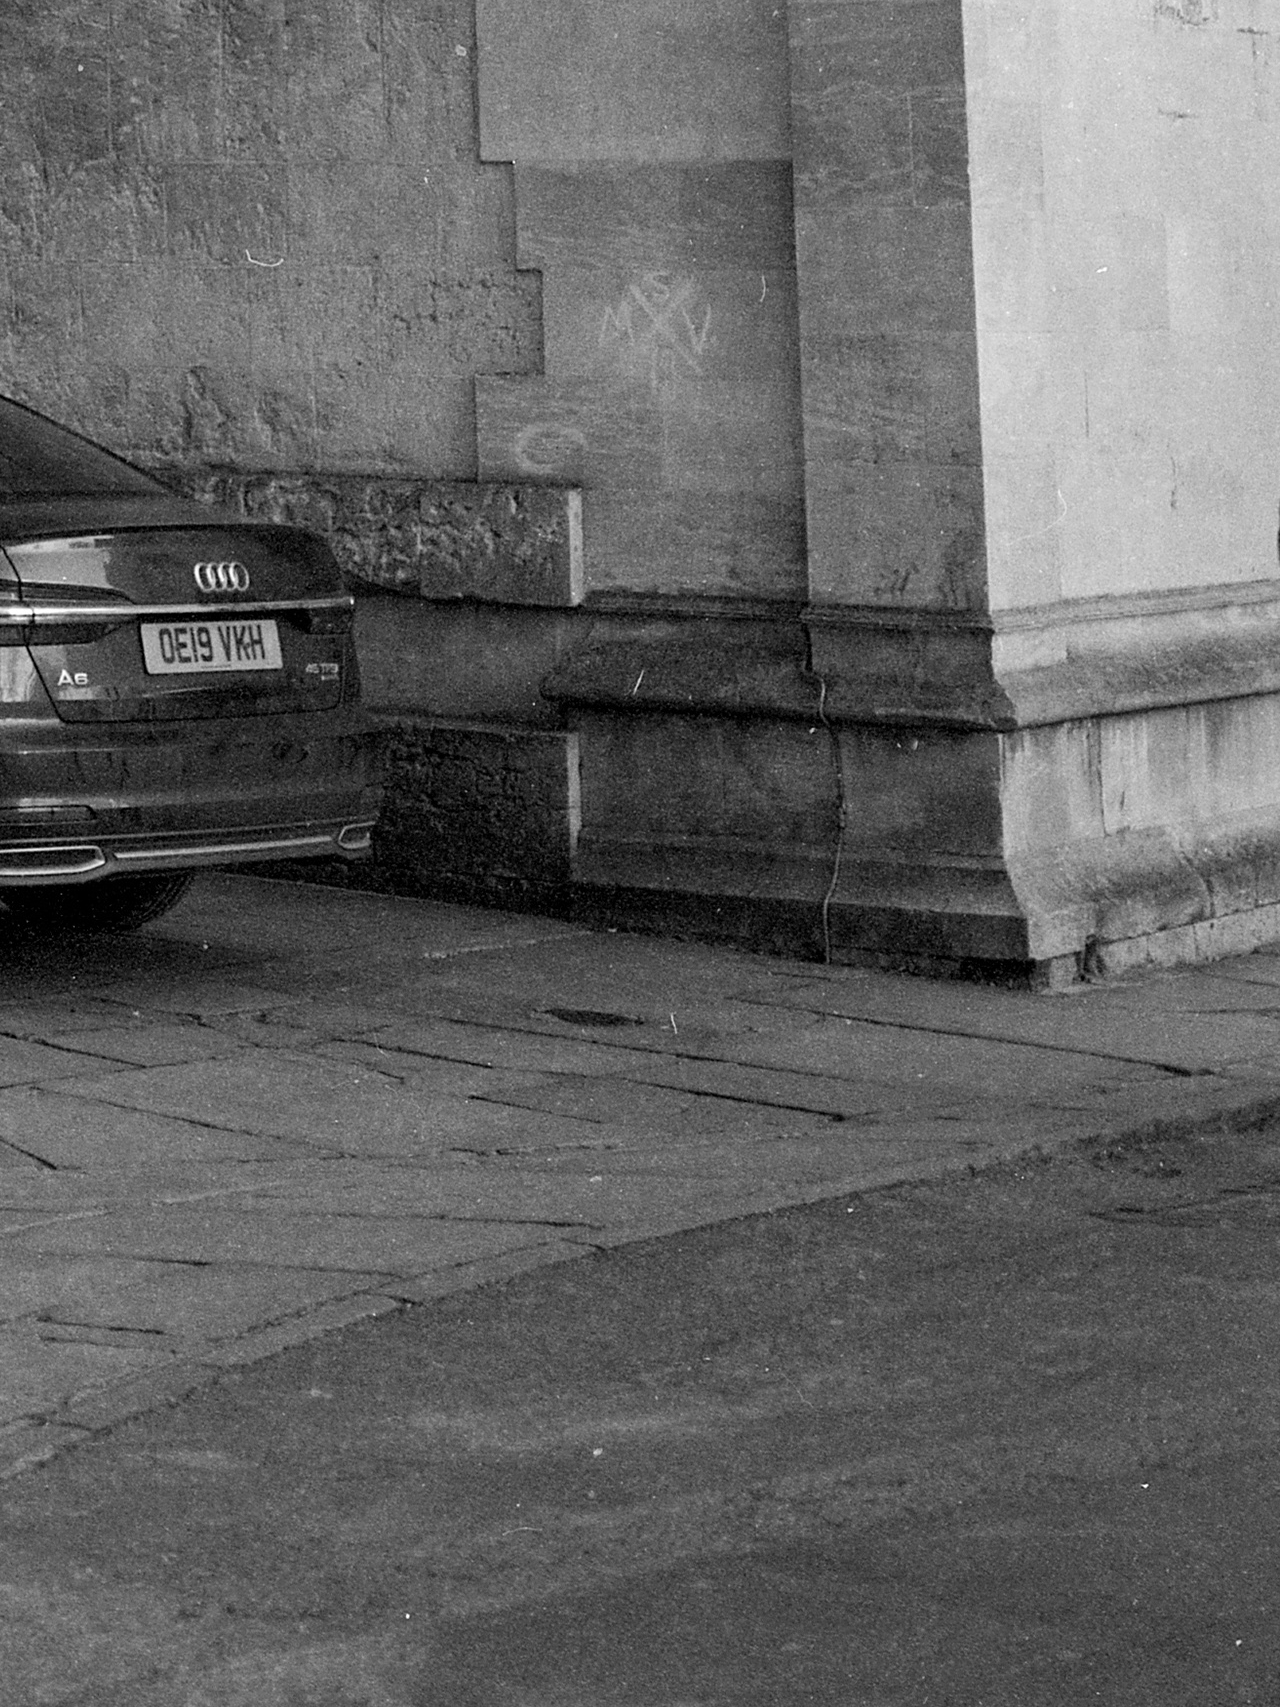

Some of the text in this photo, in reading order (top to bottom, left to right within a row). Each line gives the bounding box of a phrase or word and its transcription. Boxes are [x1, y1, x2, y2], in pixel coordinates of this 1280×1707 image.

[158, 624, 266, 664] OE19 VKH
[57, 668, 89, 686] A6
